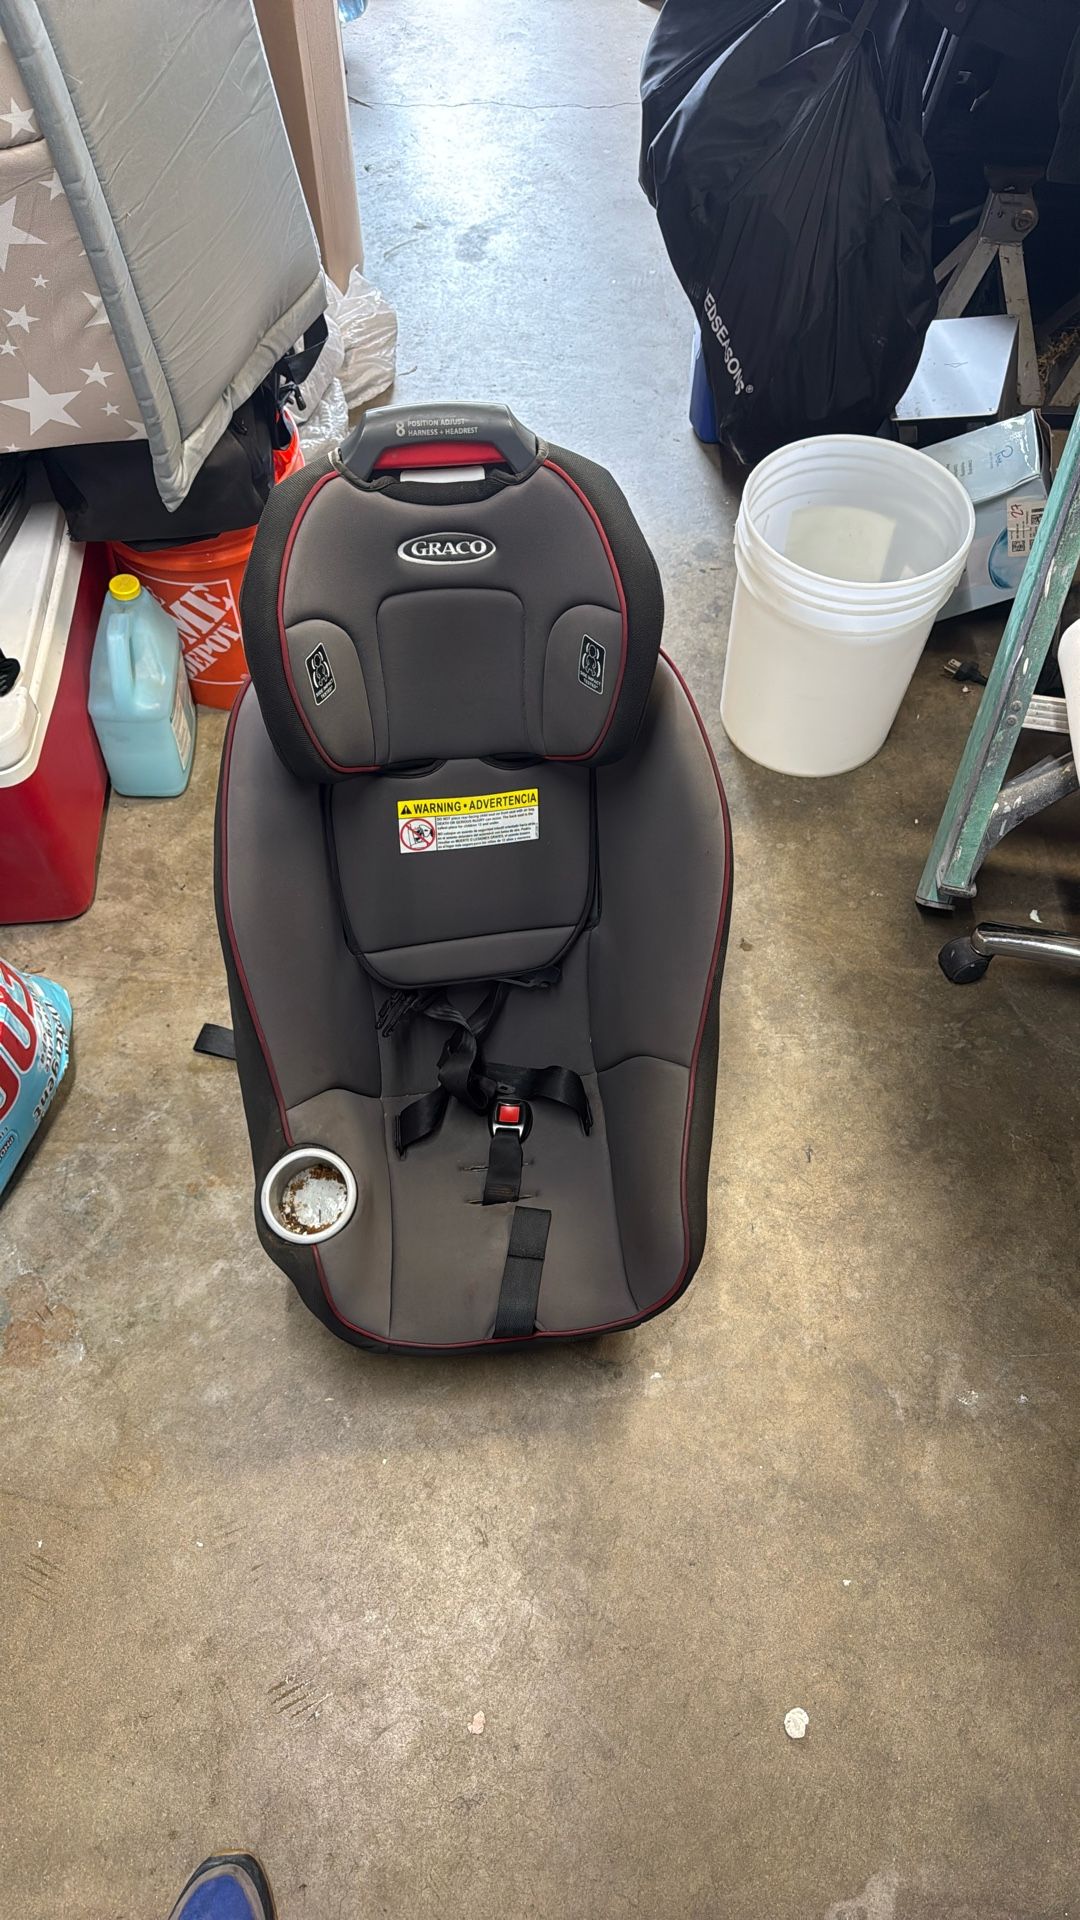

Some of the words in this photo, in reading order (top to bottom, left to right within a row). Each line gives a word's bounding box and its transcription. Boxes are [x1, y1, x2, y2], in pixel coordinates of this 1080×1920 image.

[395, 421, 406, 437] 8
[408, 419, 439, 427] POSITION
[440, 418, 465, 426] ADJUST
[408, 429, 439, 437] HARNESS
[445, 426, 479, 435] HEADREST
[411, 540, 487, 556] GRACO
[413, 801, 462, 815] WARNING
[468, 793, 537, 811] ADVERTENCIA
